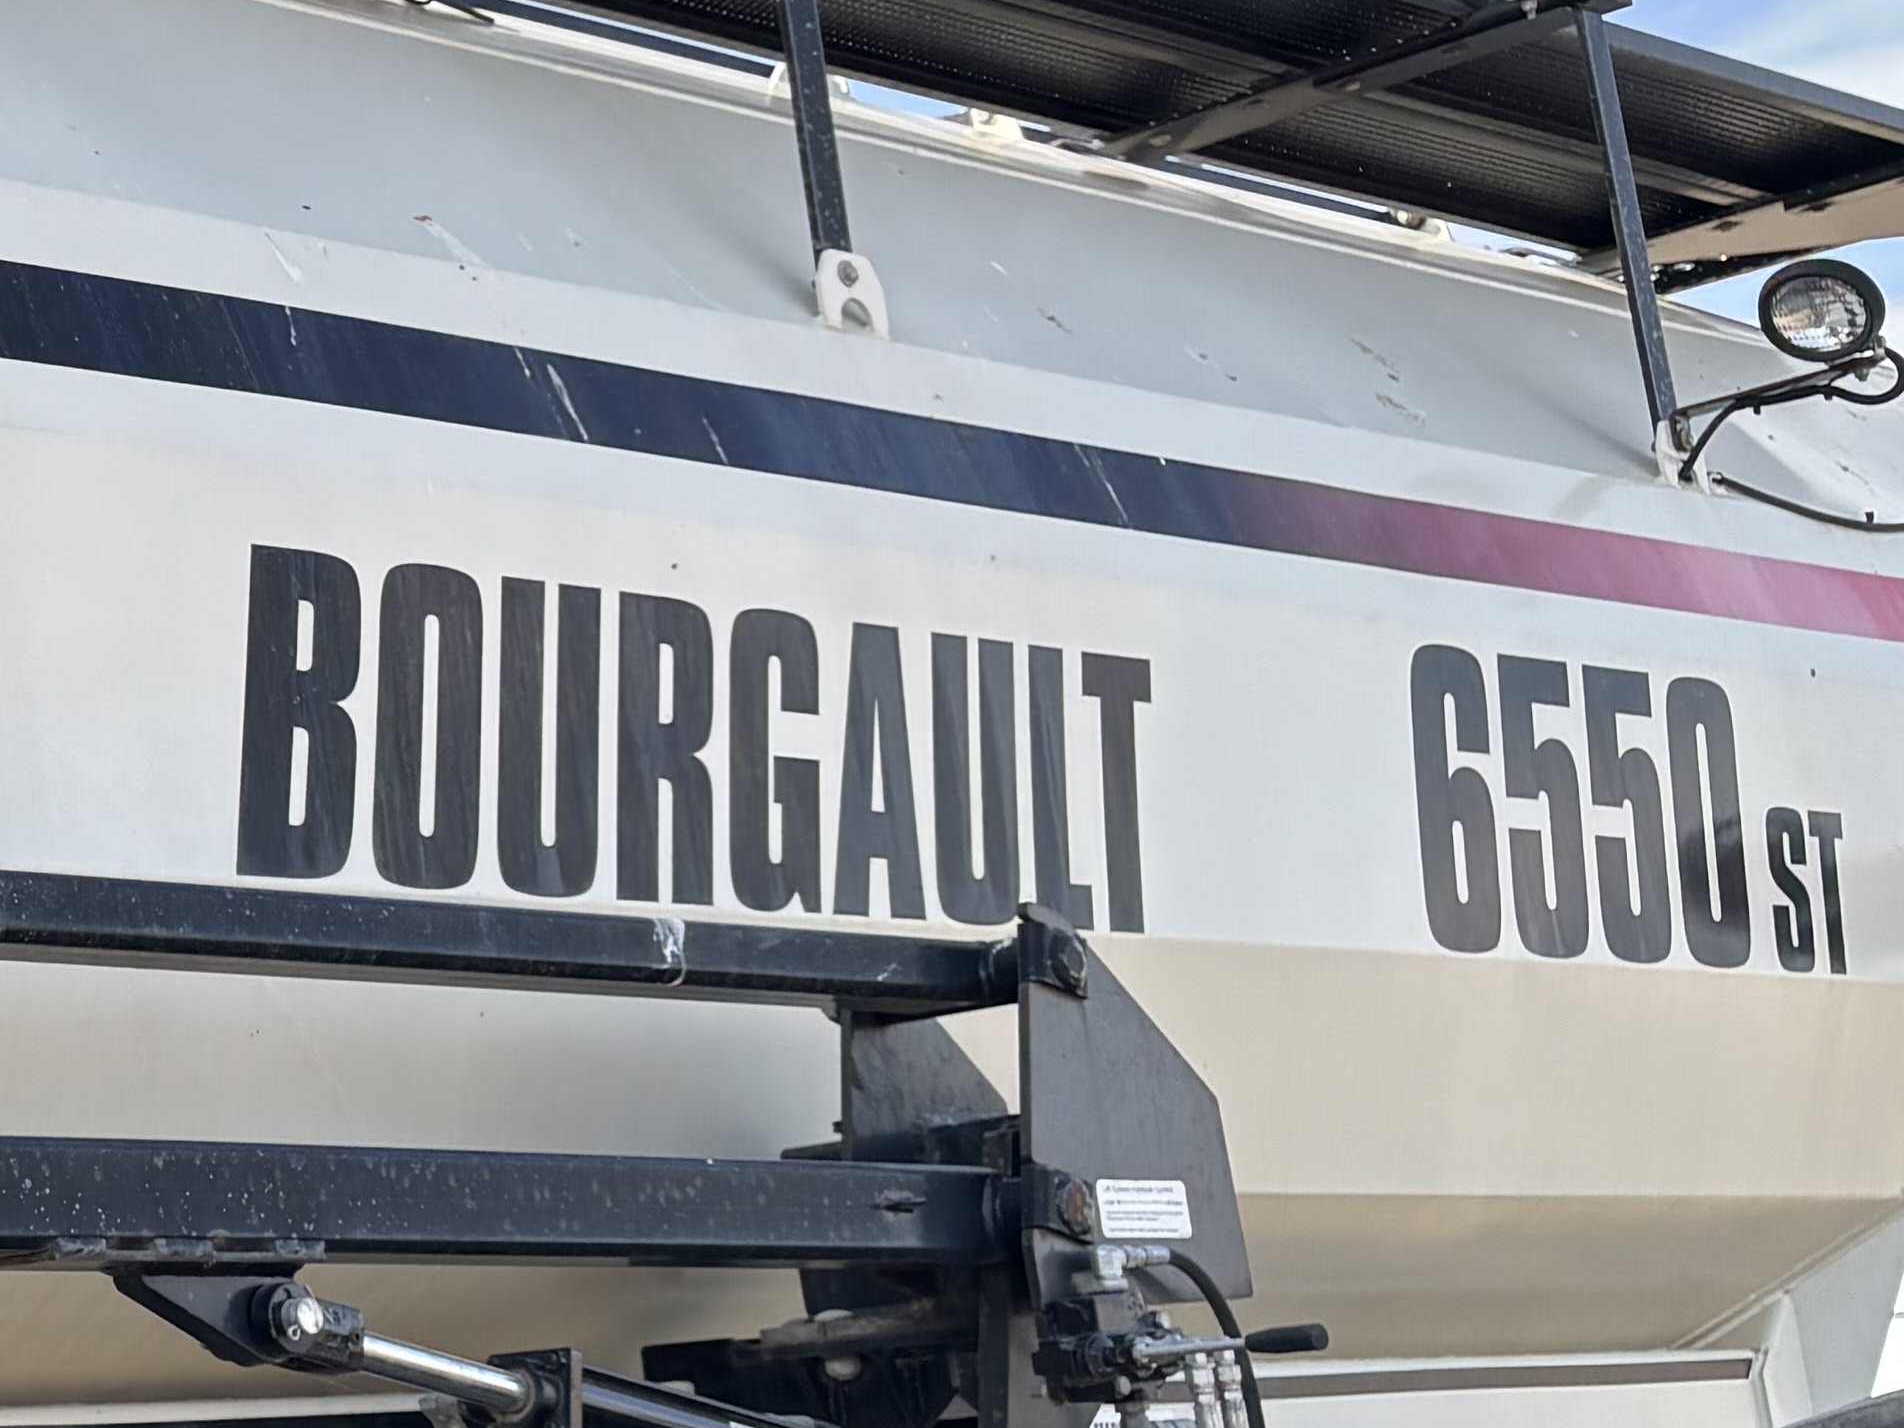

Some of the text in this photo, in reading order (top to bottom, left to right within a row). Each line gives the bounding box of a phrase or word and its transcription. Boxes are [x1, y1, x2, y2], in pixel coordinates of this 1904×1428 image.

[235, 543, 1152, 936] BOURGAULT
[1409, 643, 1848, 978] 6550 ST
